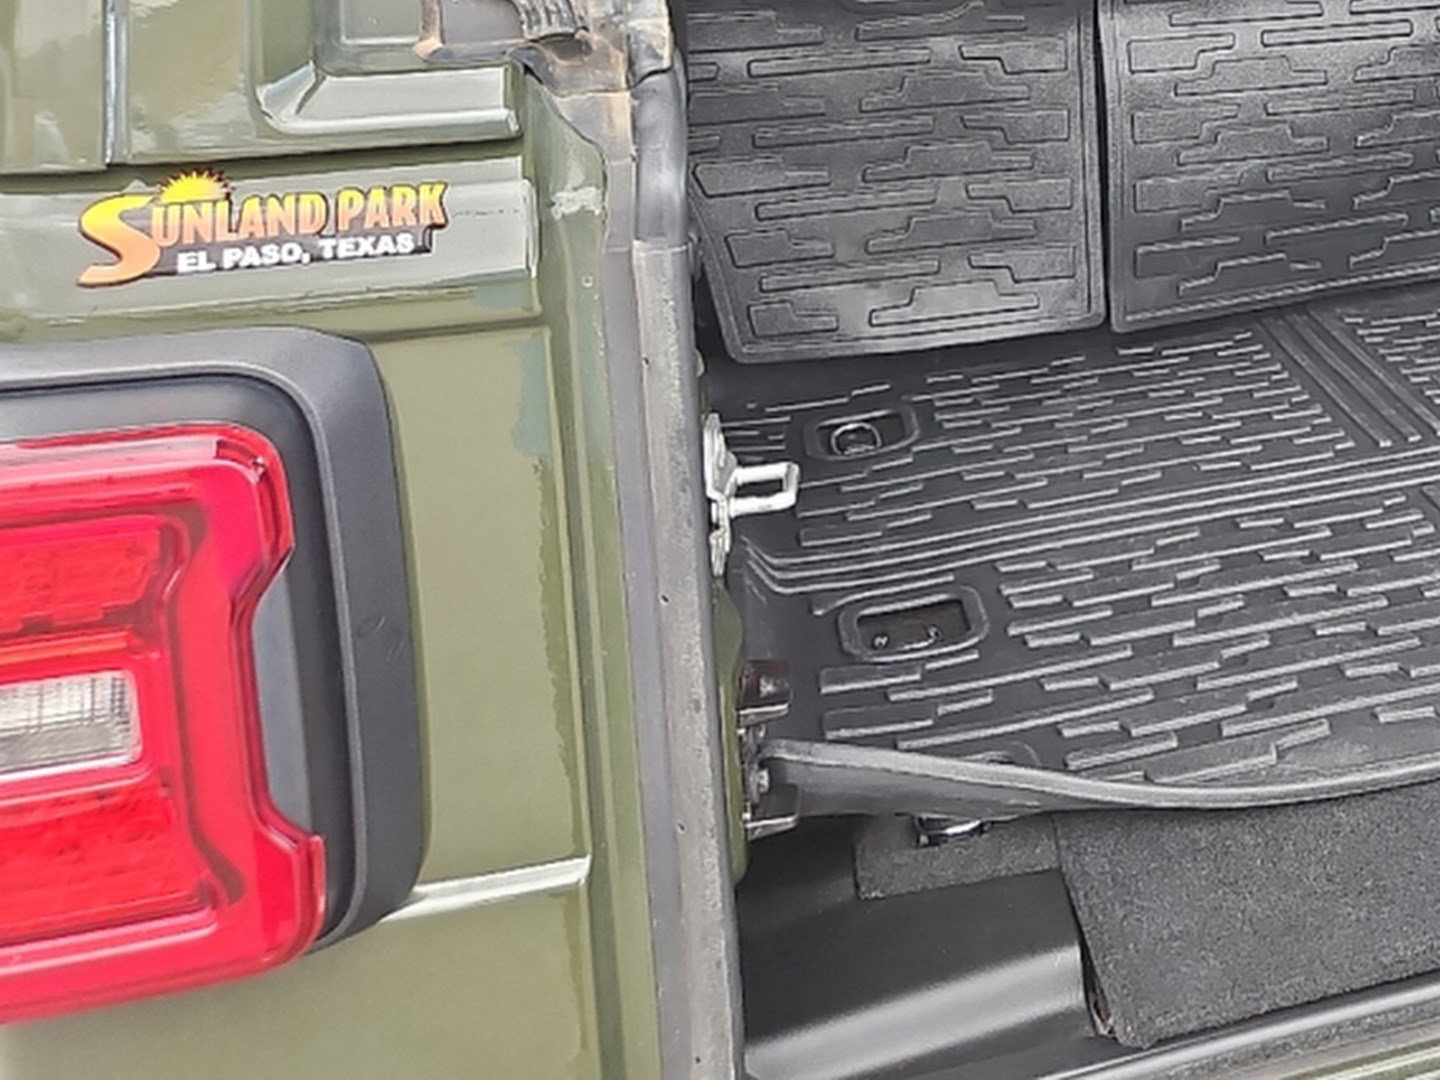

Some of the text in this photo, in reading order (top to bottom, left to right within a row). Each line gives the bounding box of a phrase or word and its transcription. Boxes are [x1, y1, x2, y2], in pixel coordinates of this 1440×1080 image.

[78, 183, 450, 287] SUNLAND PARK
[176, 232, 416, 275] EL PASO, TEXAS
